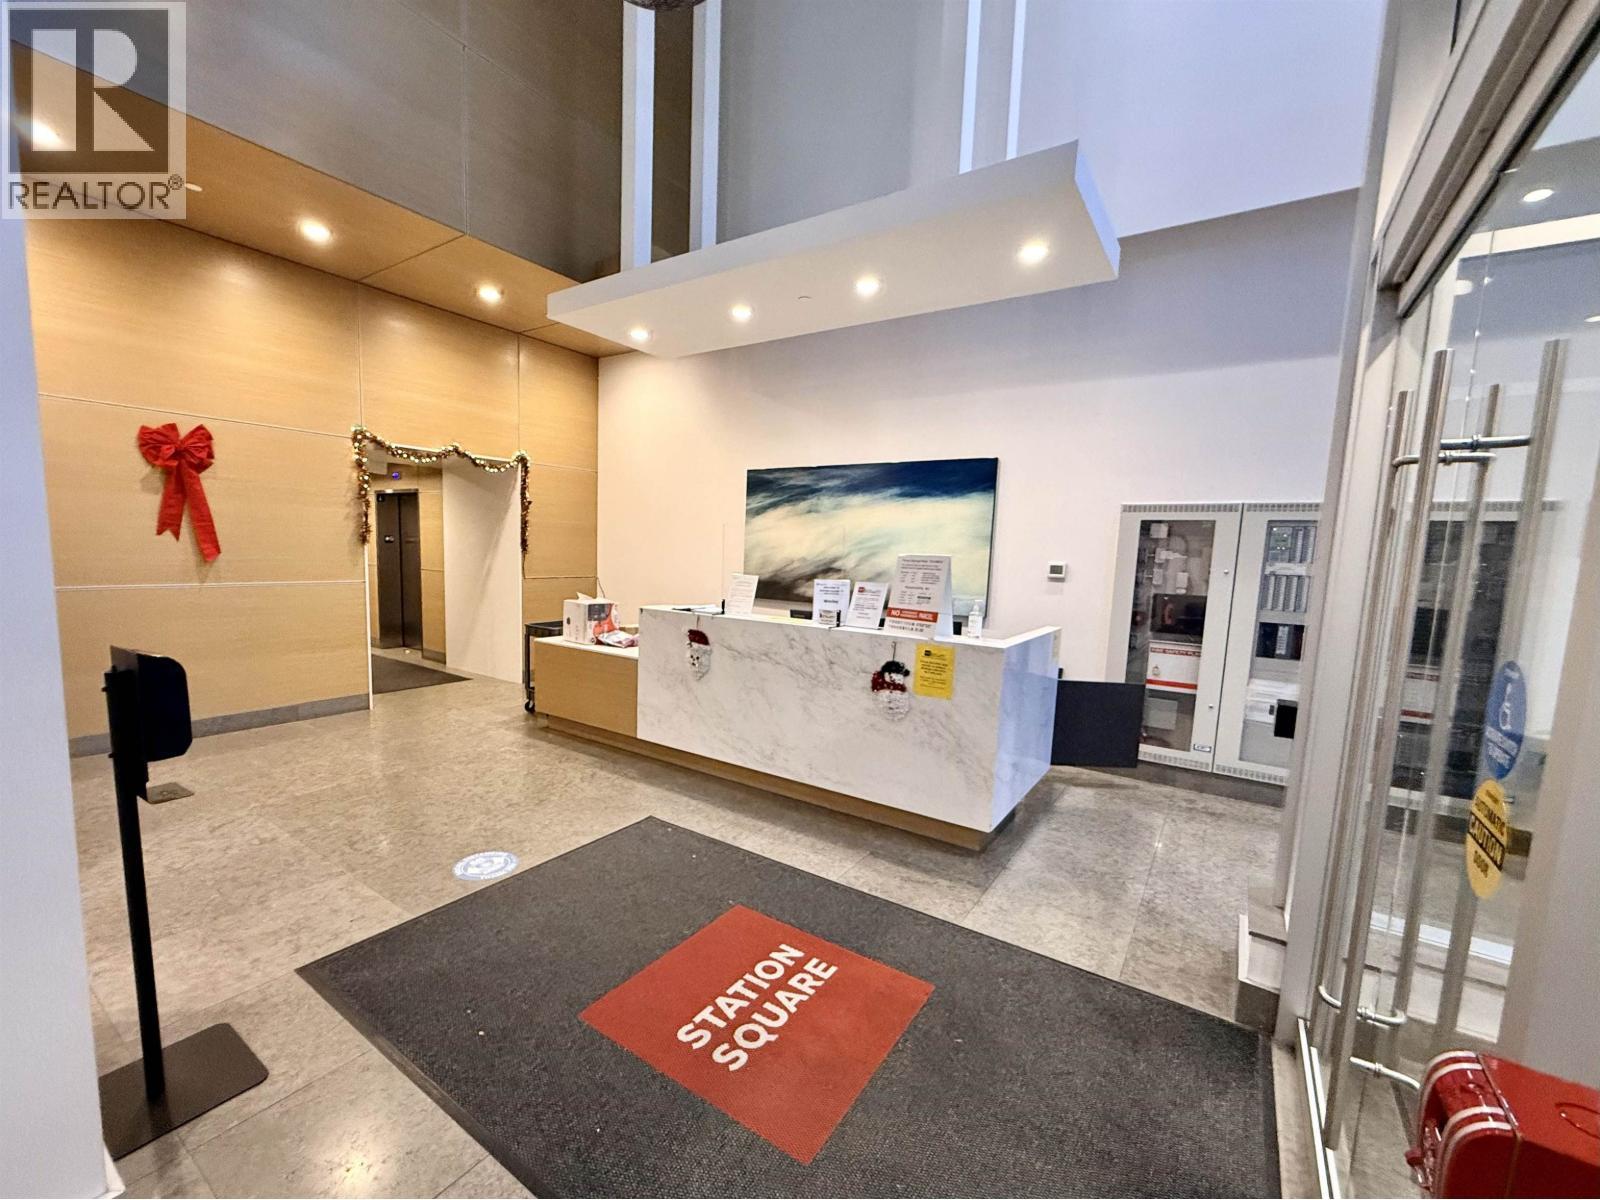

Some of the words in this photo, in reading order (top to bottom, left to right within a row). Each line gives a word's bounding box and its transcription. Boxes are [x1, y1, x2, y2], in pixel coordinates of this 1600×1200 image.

[1469, 814, 1504, 867] CAUTION
[676, 944, 805, 1050] STATION
[712, 957, 838, 1072] SQUARE
